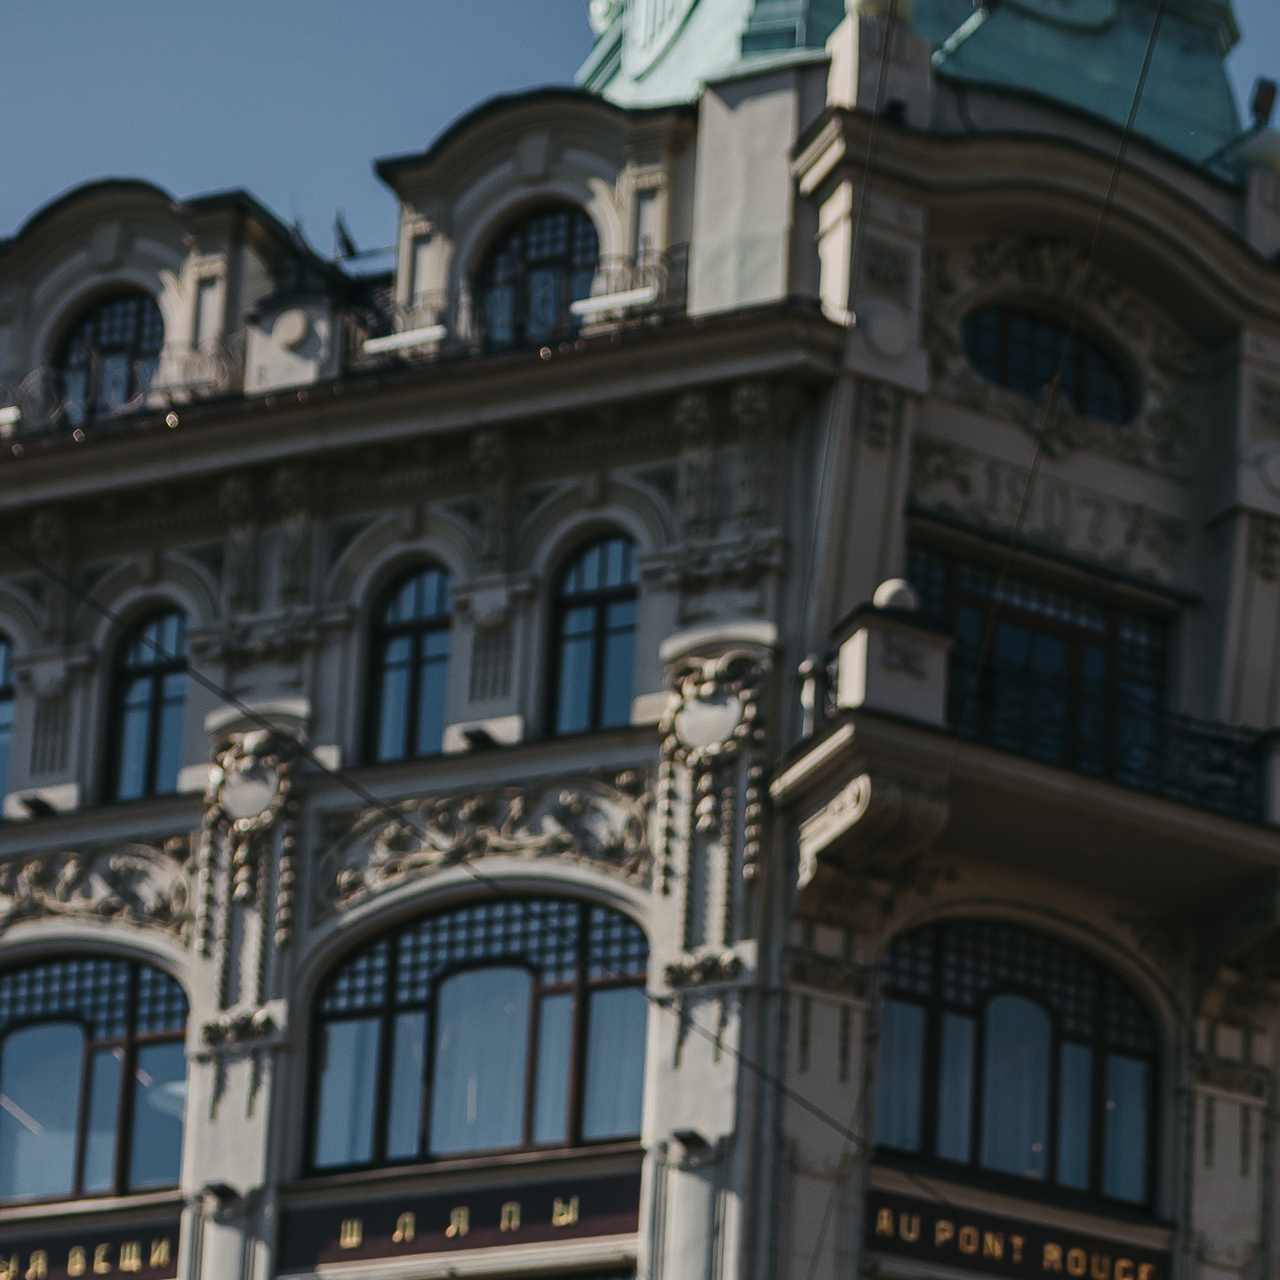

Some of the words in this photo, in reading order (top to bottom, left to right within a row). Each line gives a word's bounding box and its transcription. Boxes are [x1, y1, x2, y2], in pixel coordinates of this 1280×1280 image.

[339, 1195, 580, 1249] ШЛЯПЫ
[875, 1208, 921, 1243] AU
[934, 1219, 1026, 1265] PONT
[67, 1238, 171, 1277] ВЕЩИ
